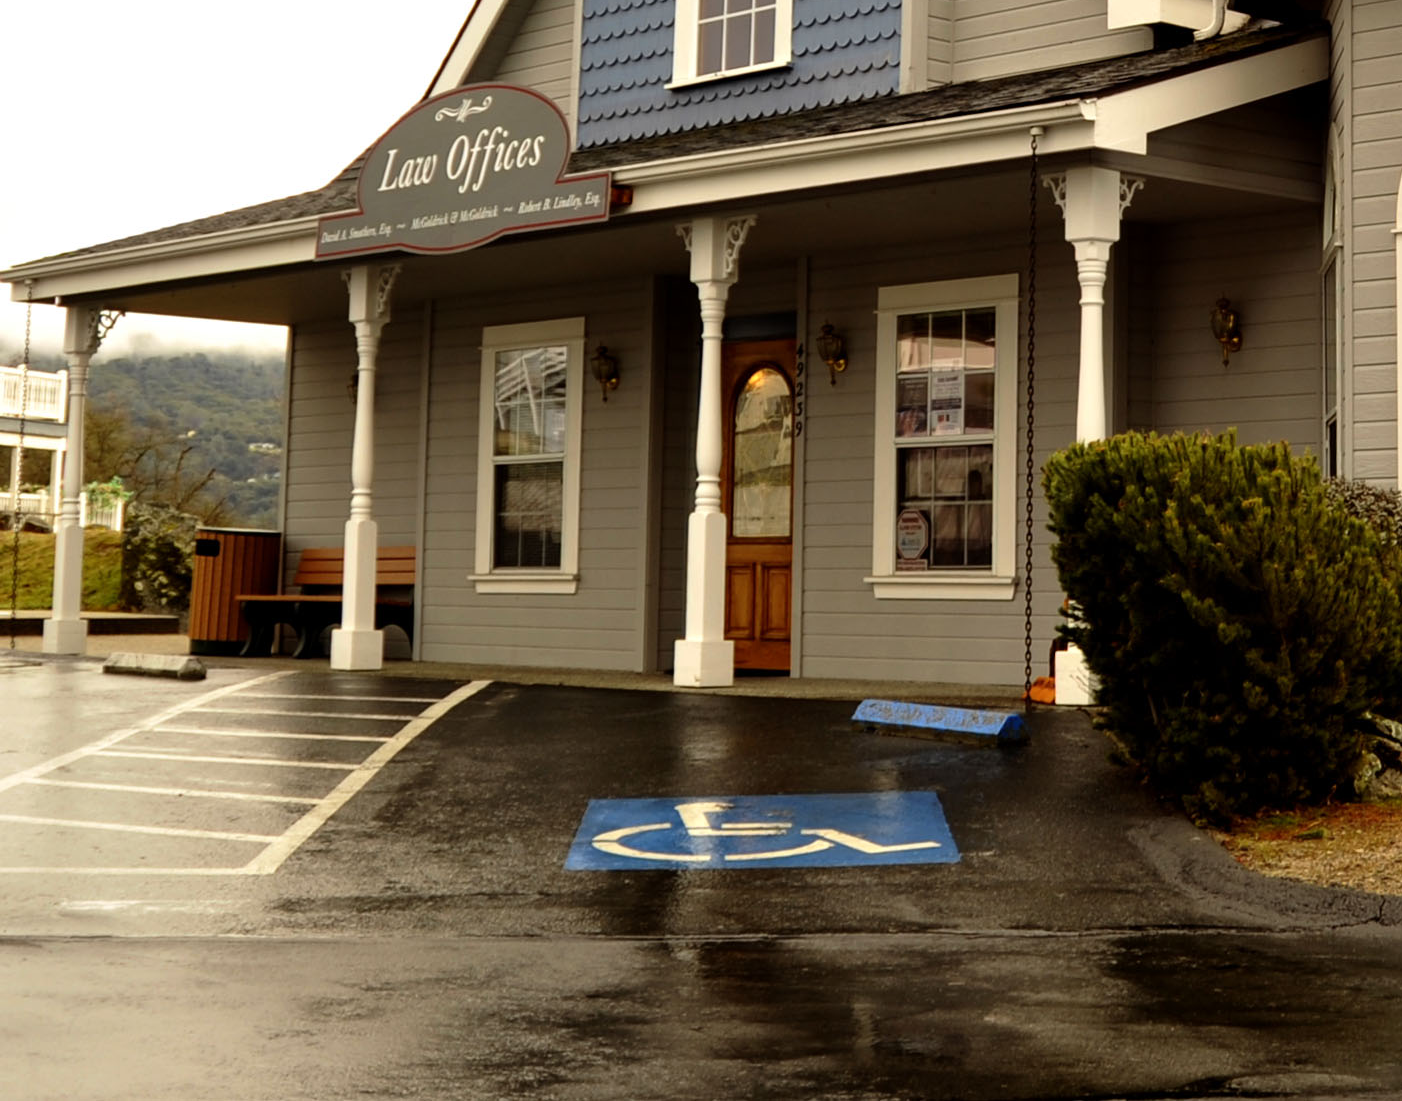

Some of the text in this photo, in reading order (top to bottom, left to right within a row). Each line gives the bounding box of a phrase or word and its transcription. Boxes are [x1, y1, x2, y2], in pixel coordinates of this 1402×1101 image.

[377, 126, 545, 194] Law Offices
[449, 211, 459, 224] &
